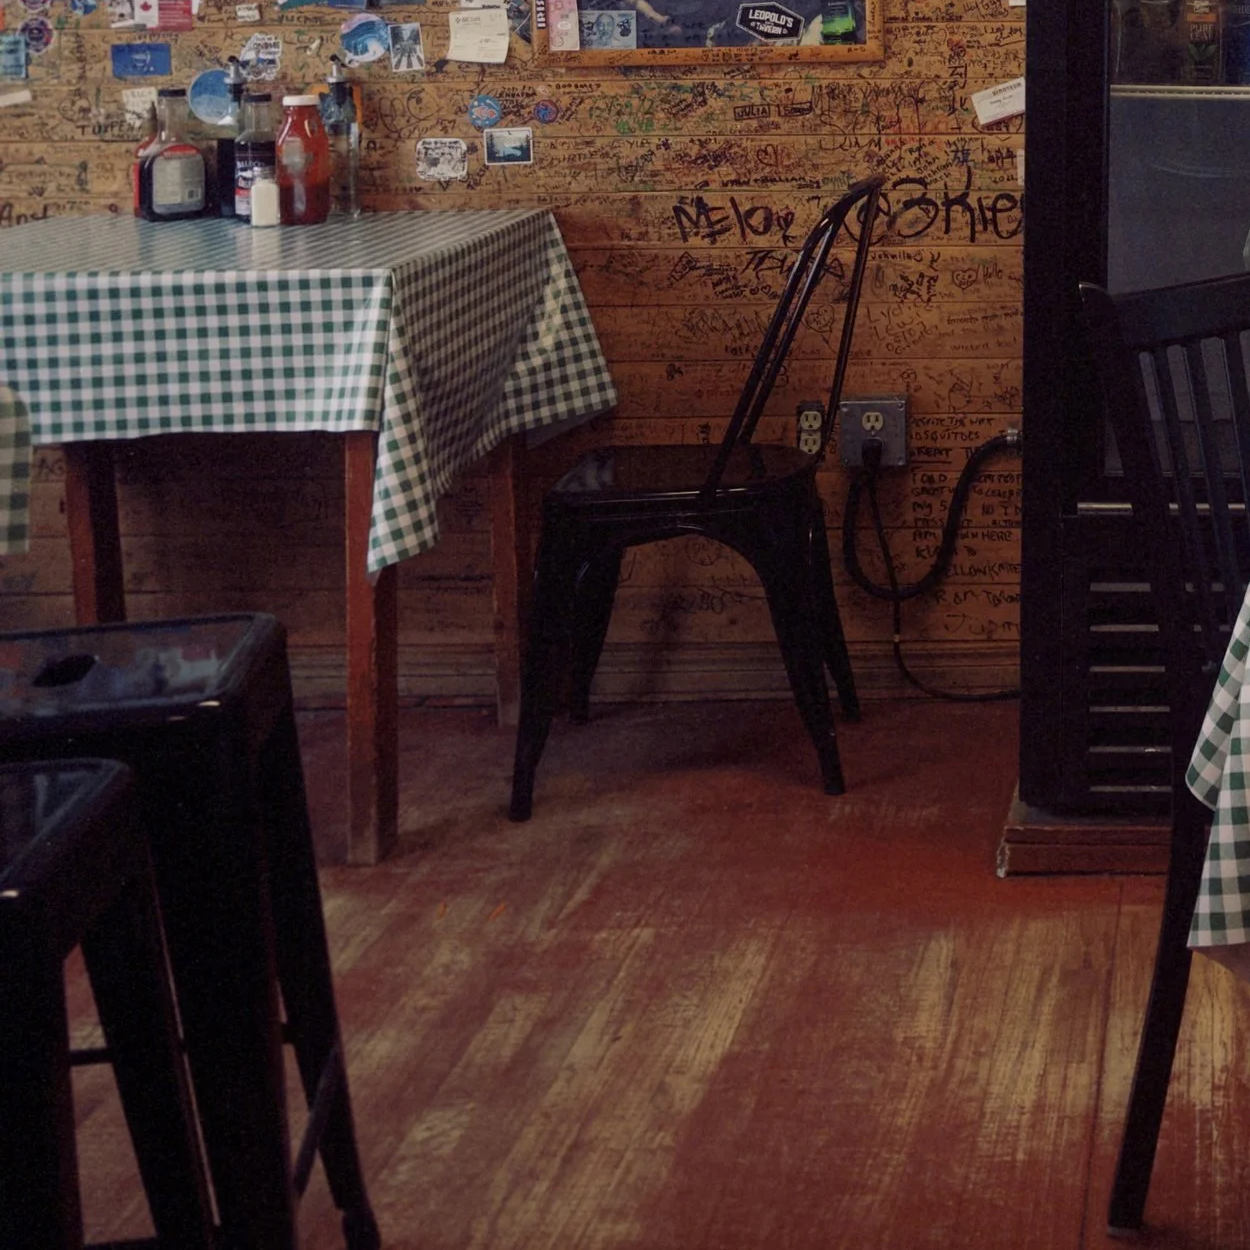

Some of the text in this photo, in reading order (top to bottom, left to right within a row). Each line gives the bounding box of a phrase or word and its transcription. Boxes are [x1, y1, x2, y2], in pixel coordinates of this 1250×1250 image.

[748, 8, 794, 28] LEOPOLD'S
[756, 22, 783, 35] TAVERN
[911, 431, 980, 443] OSQUITOES
[981, 530, 1014, 542] HERE
